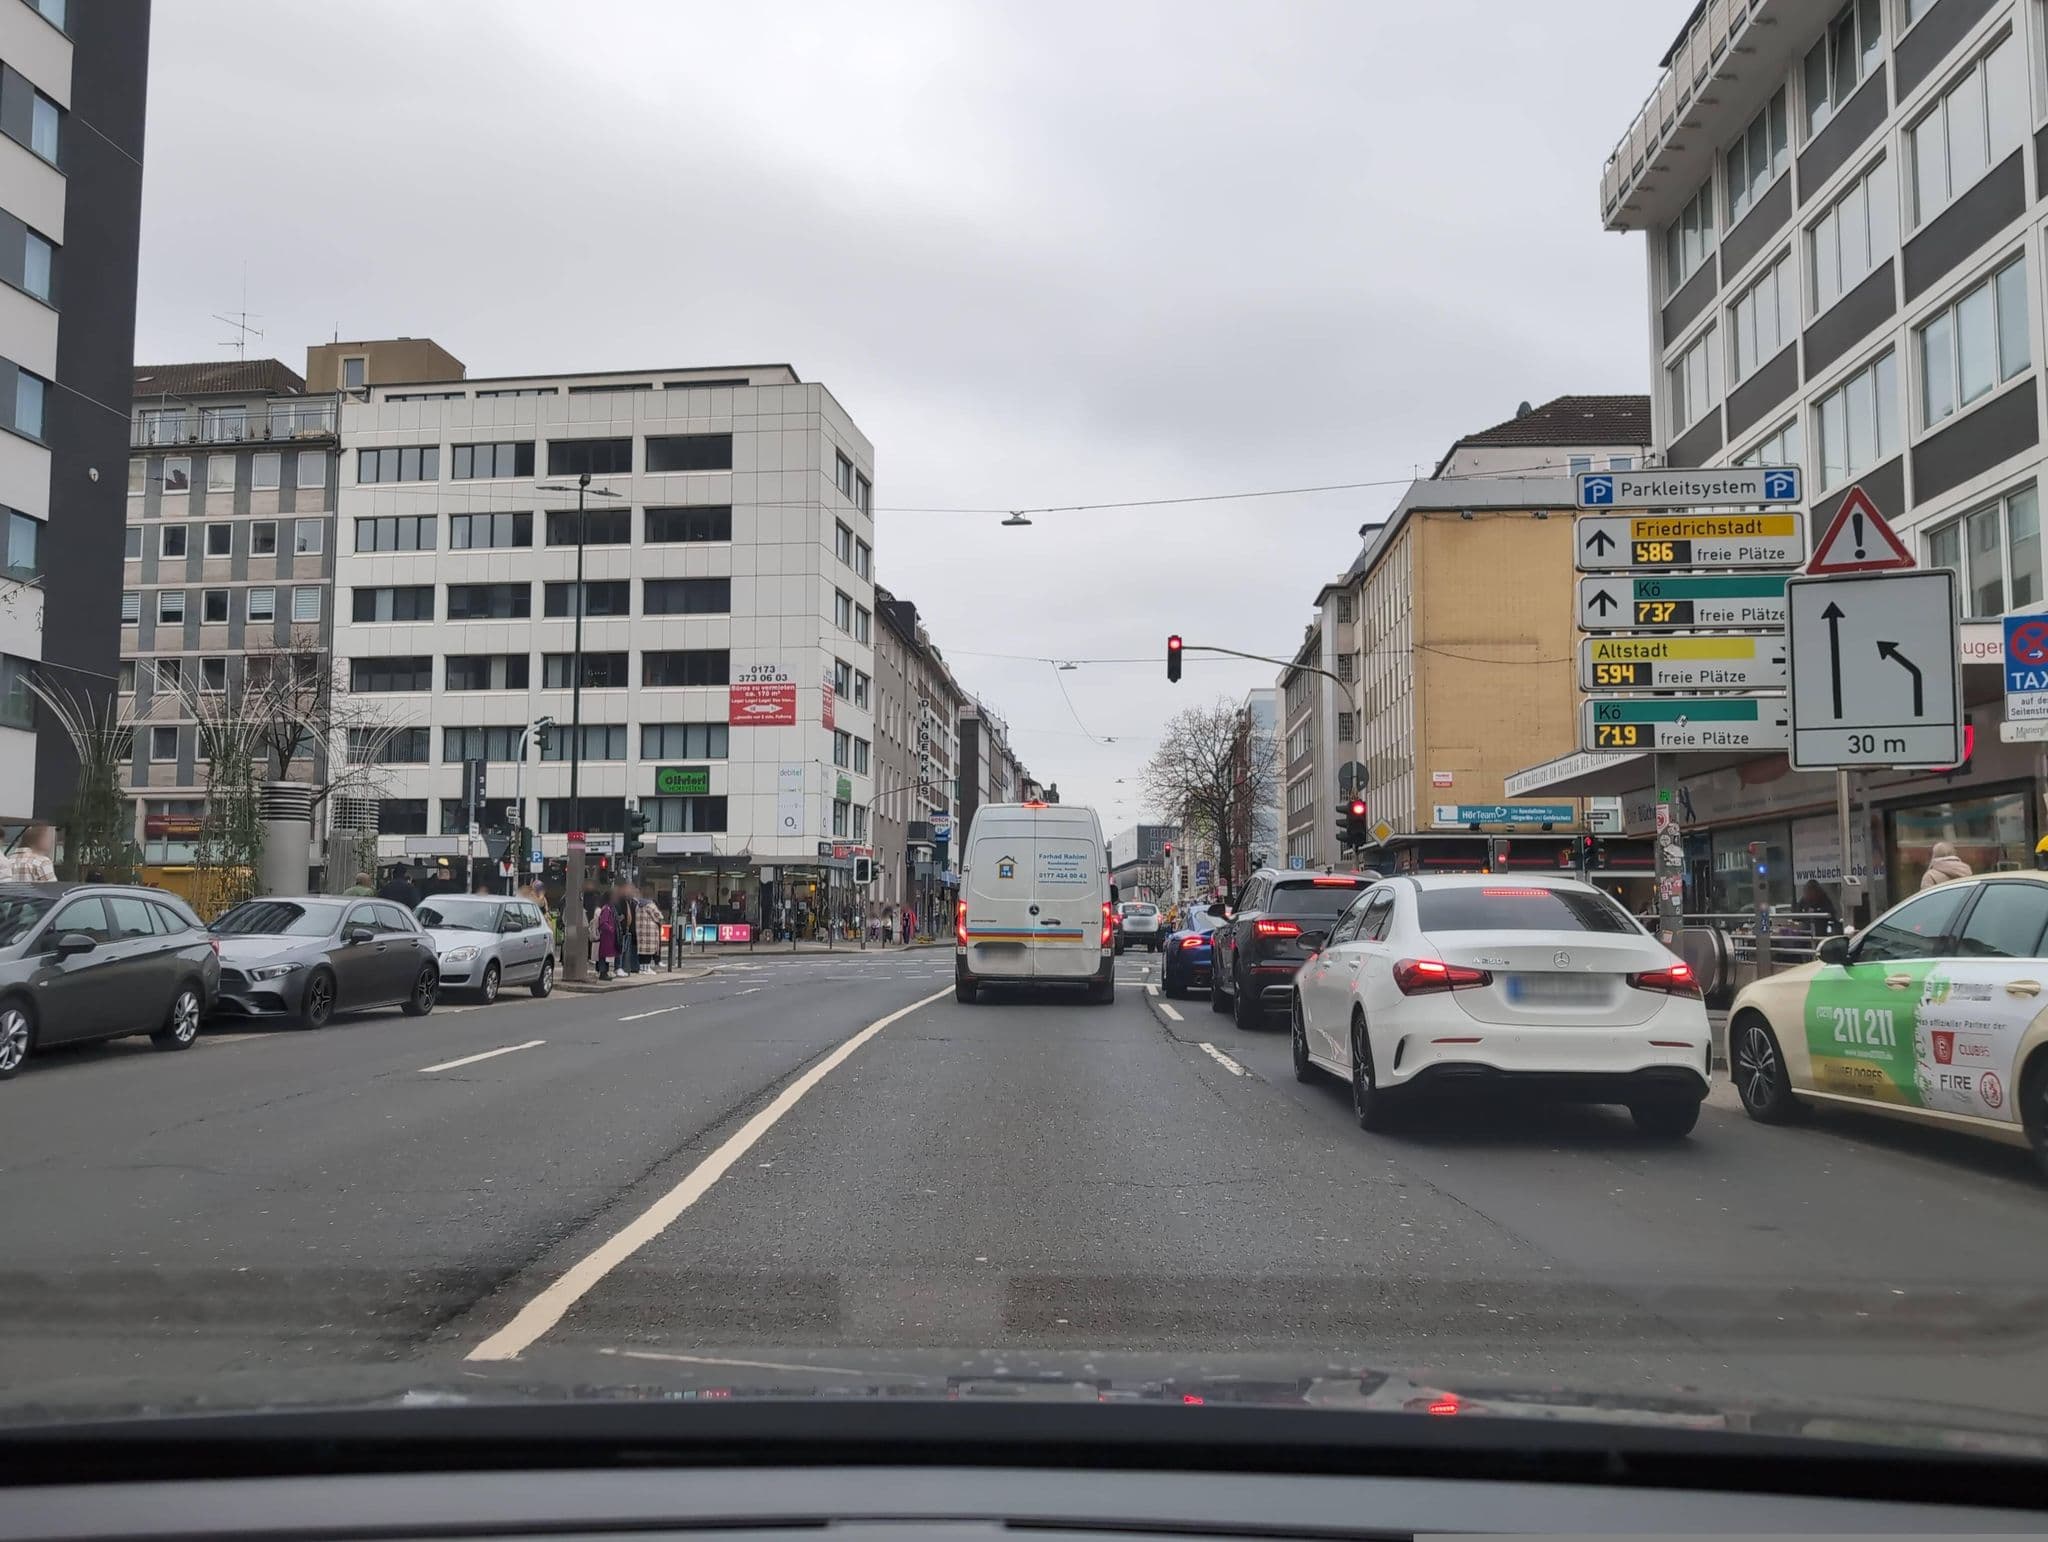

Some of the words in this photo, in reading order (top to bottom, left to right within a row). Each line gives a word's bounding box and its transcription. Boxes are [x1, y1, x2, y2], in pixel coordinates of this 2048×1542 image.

[1621, 480, 1757, 498] Parkleitsystem
[1636, 519, 1763, 537] Friedrichstadt
[1636, 542, 1673, 562] 586
[1698, 548, 1732, 561] freie
[1739, 546, 1785, 560] Plätze
[1638, 583, 1661, 597] Kö
[1638, 603, 1676, 622] 737
[1700, 609, 1735, 622] freie
[1741, 607, 1785, 621] Plätze
[1597, 643, 1668, 659] Altstadt
[738, 674, 757, 682] 373
[760, 674, 772, 682] 06
[1596, 664, 1634, 684] 594
[1658, 671, 1693, 684] freie
[1700, 670, 1746, 683] Plätze
[1599, 704, 1621, 719] Kö
[1599, 725, 1637, 745] 719
[1661, 732, 1696, 745] freie
[1703, 732, 1750, 745] Plätze
[1848, 734, 1875, 754] 30
[1884, 739, 1906, 753] m
[921, 700, 930, 795] DINGERKUS
[1833, 1007, 1862, 1043] 211
[1864, 1008, 1896, 1047] 211
[1940, 1074, 1972, 1091] FIRE
